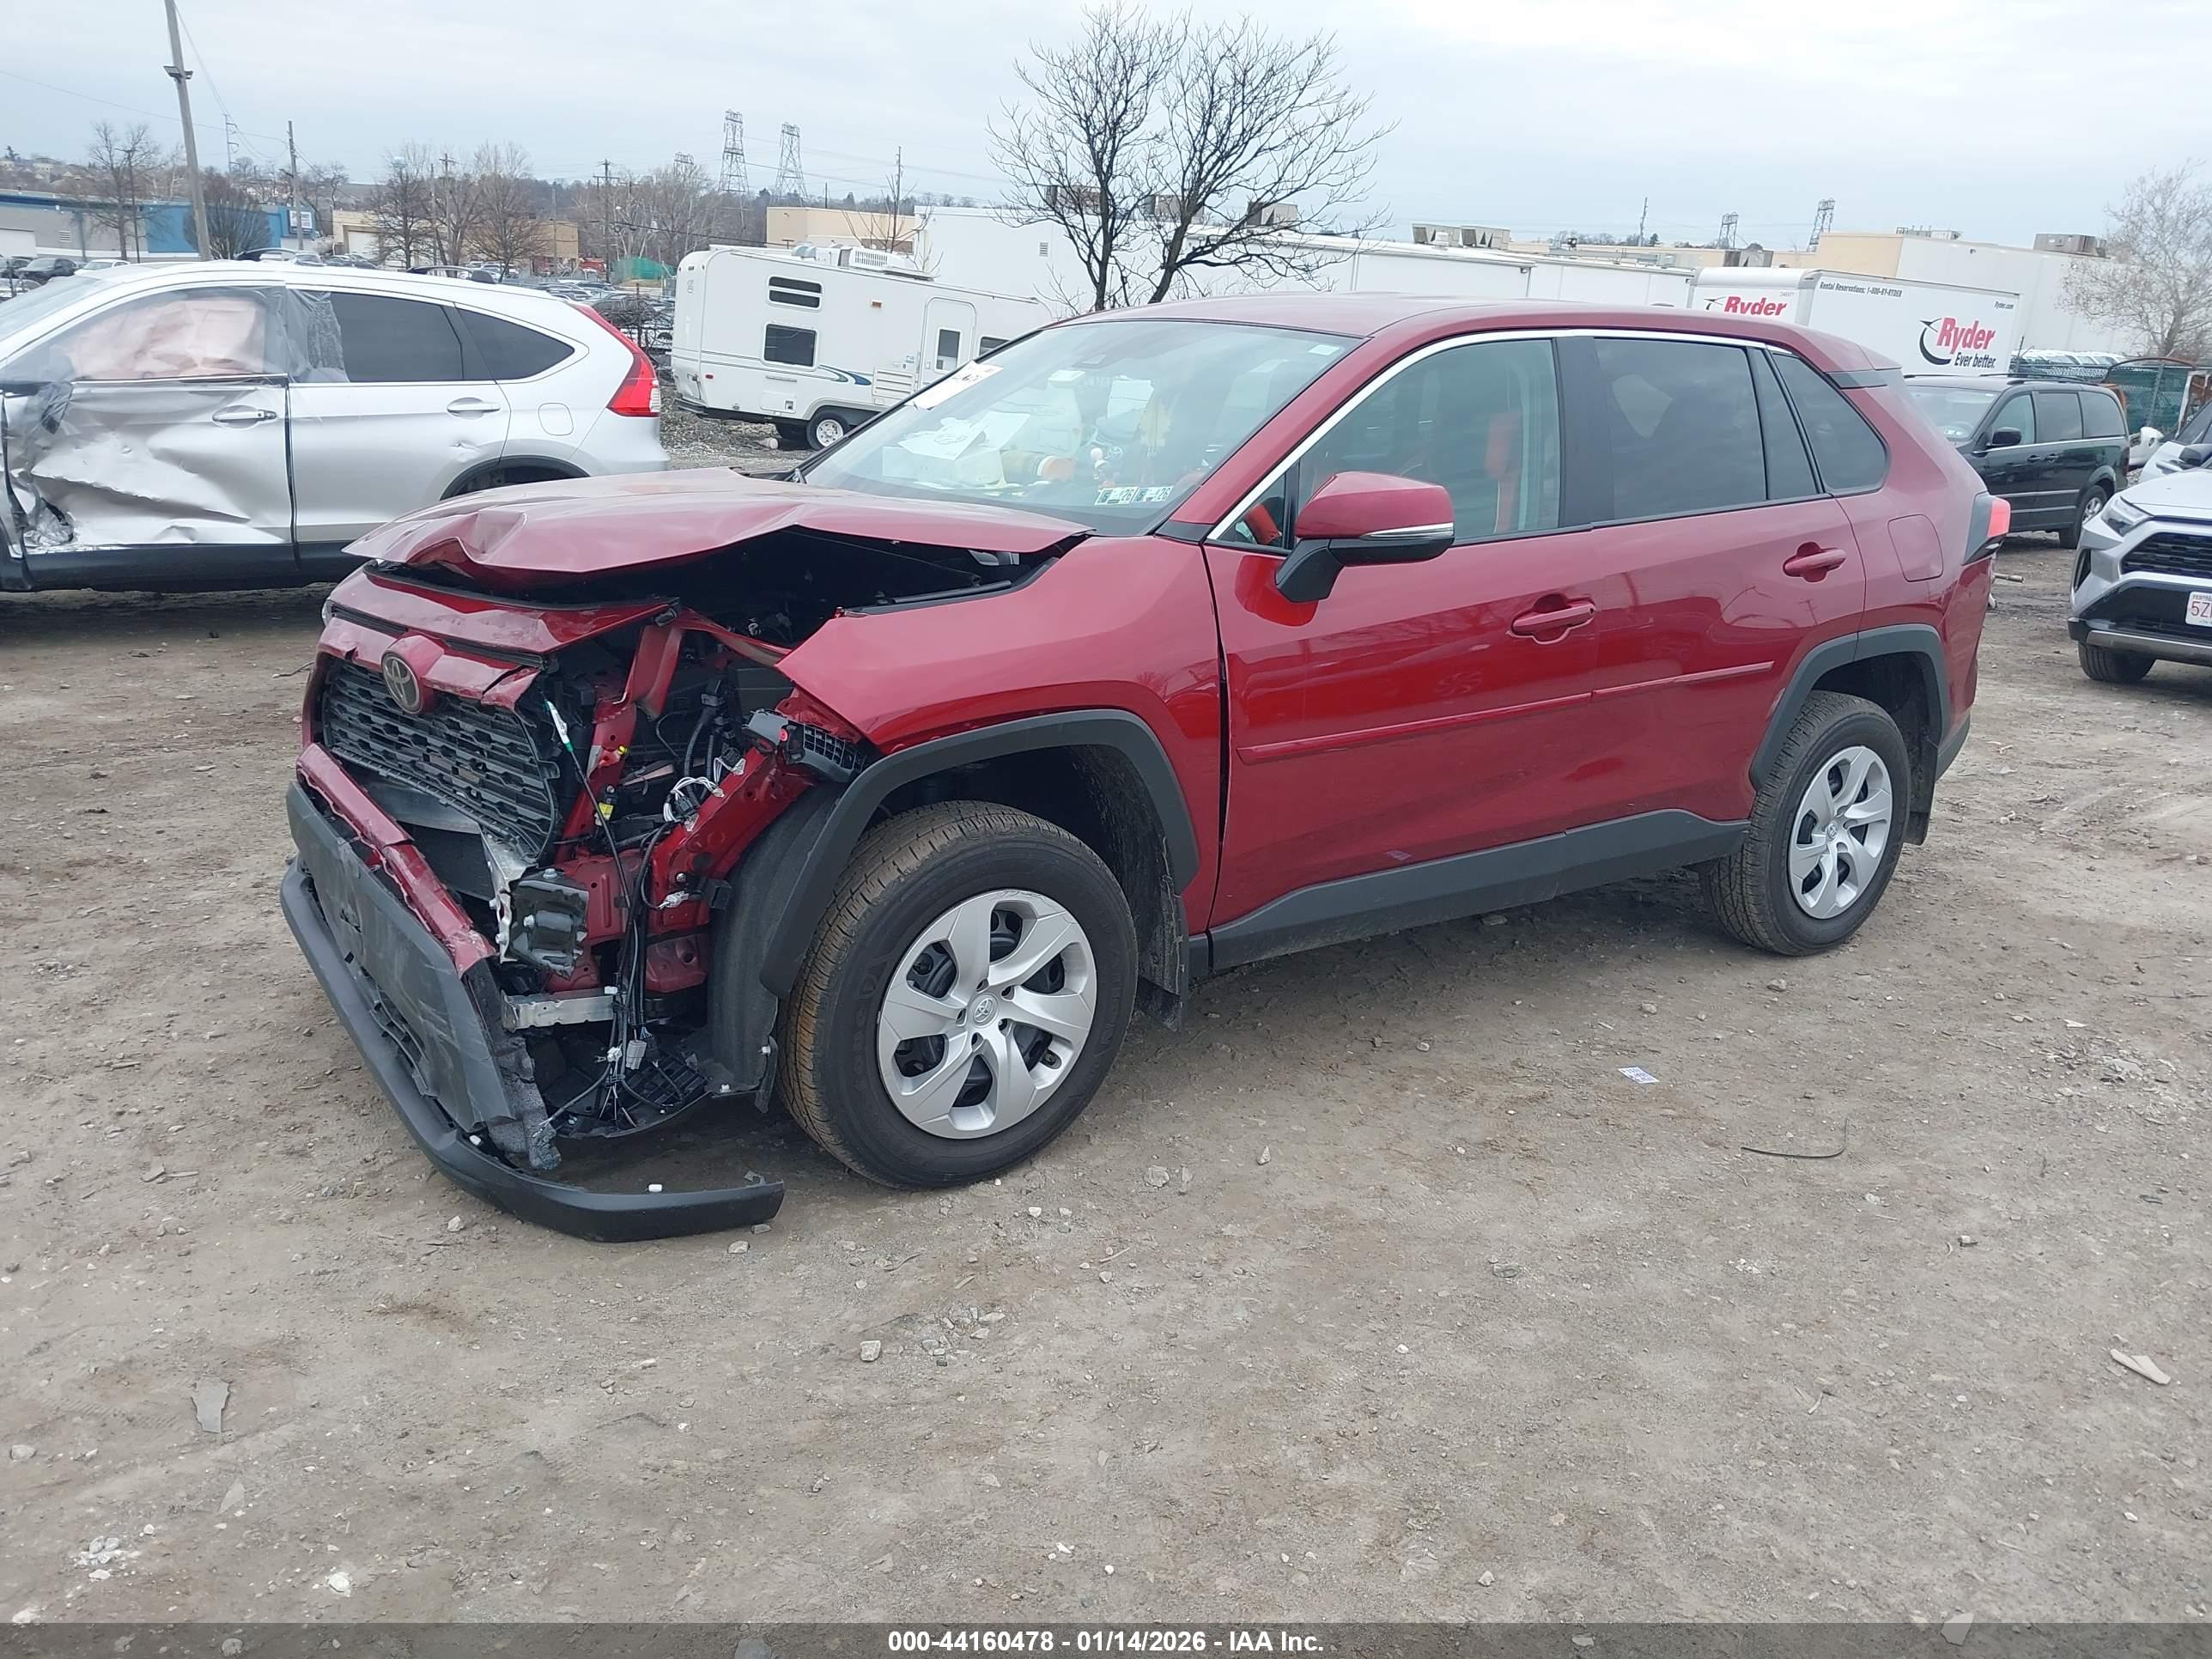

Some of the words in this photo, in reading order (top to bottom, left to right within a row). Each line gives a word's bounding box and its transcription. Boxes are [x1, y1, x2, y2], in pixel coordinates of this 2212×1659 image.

[1819, 281, 1836, 290] Rental
[1936, 317, 1996, 355] Ryder
[1954, 351, 1972, 368] Ever
[2191, 600, 2212, 618] 5Z
